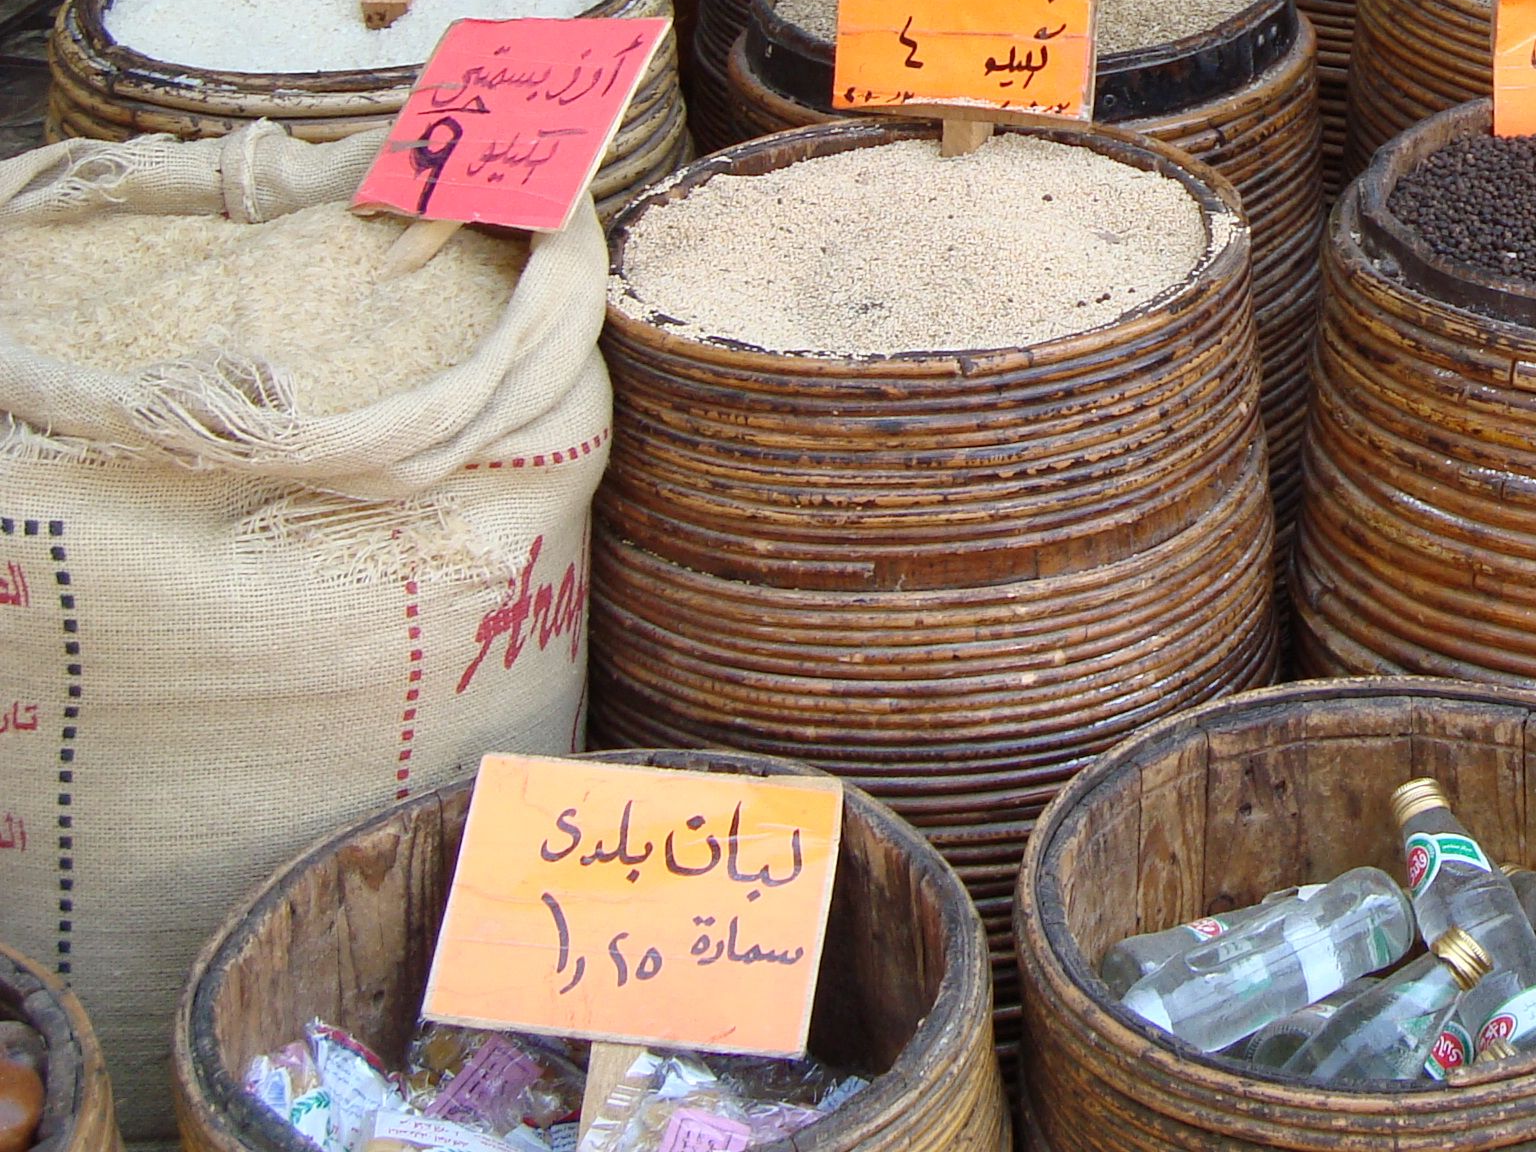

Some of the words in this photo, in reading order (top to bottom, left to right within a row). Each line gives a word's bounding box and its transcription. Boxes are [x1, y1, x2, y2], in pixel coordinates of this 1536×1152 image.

[899, 15, 924, 69] ٤
[409, 115, 463, 215] ٩
[665, 800, 804, 902] لبان
